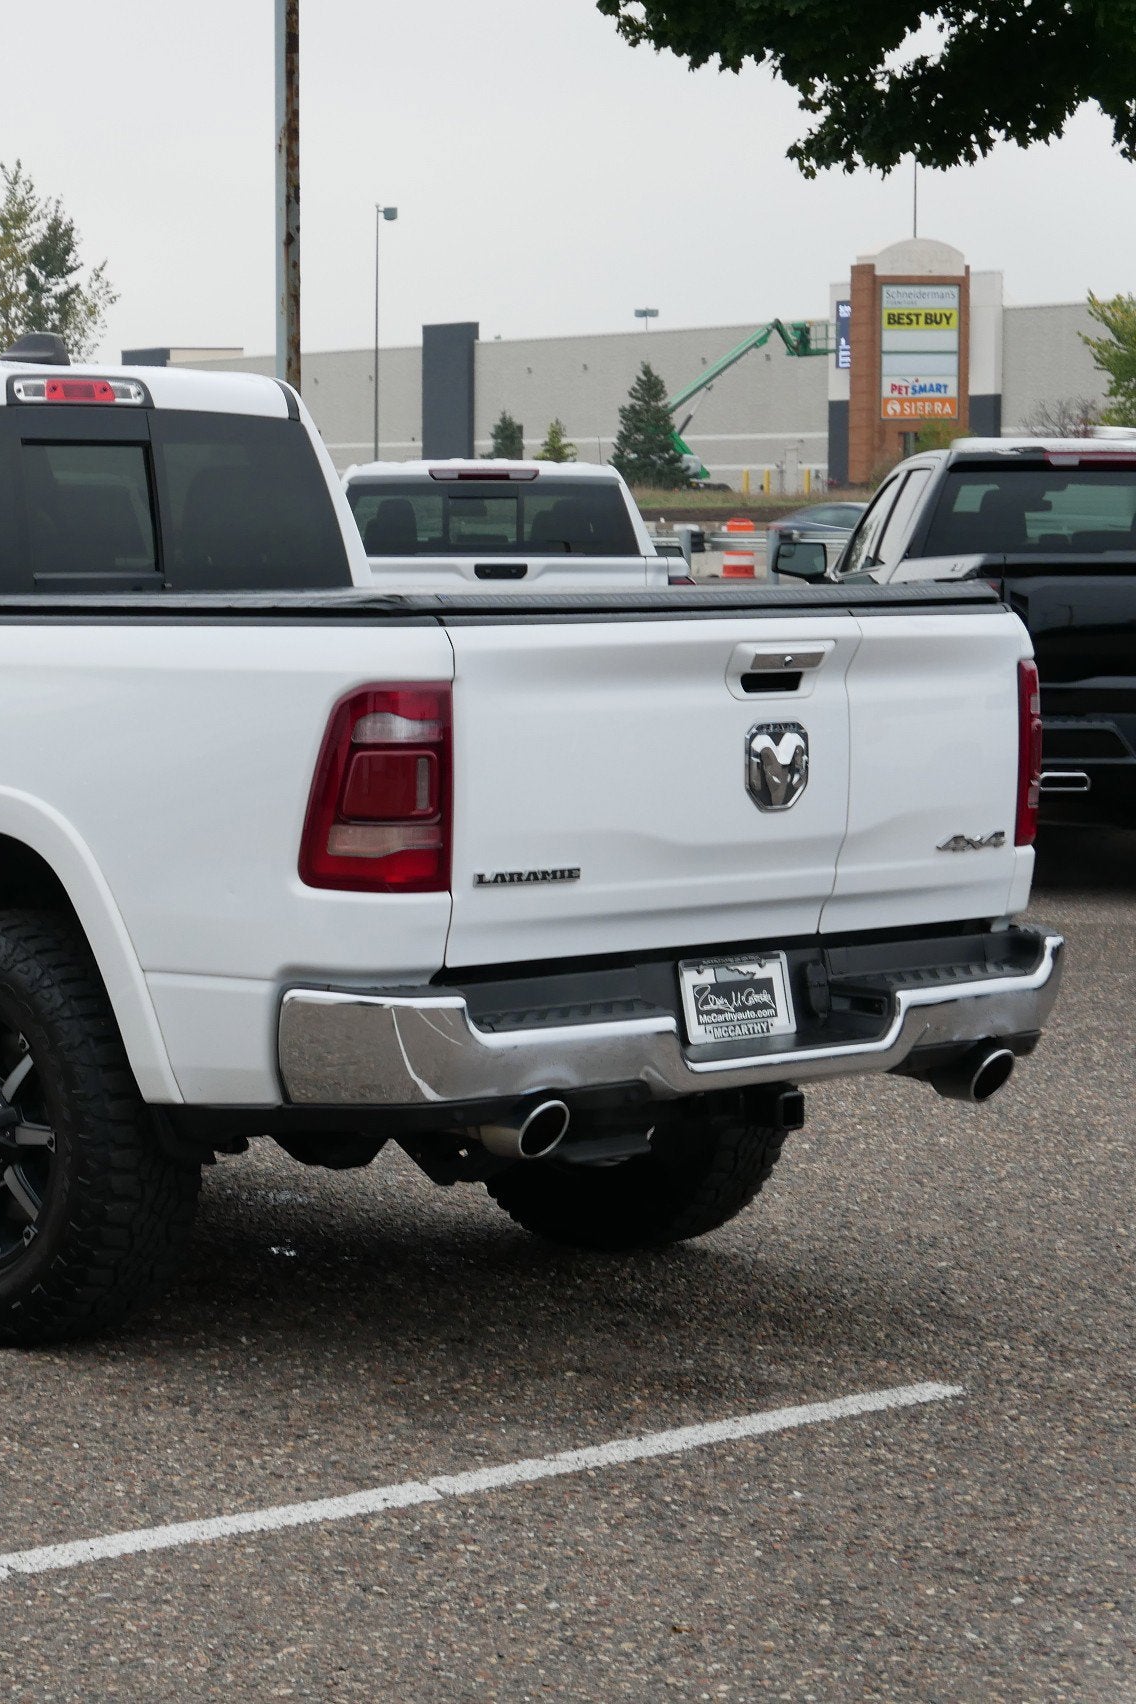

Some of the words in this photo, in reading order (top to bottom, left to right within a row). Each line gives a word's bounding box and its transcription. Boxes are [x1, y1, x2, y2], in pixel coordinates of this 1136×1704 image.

[886, 311, 921, 326] BEST
[924, 311, 953, 326] BUY
[902, 401, 952, 415] SIERRA
[473, 867, 581, 888] LARAMIE
[698, 1008, 776, 1024] McCarthyauto.com
[712, 1020, 769, 1039] MCCARTHY
